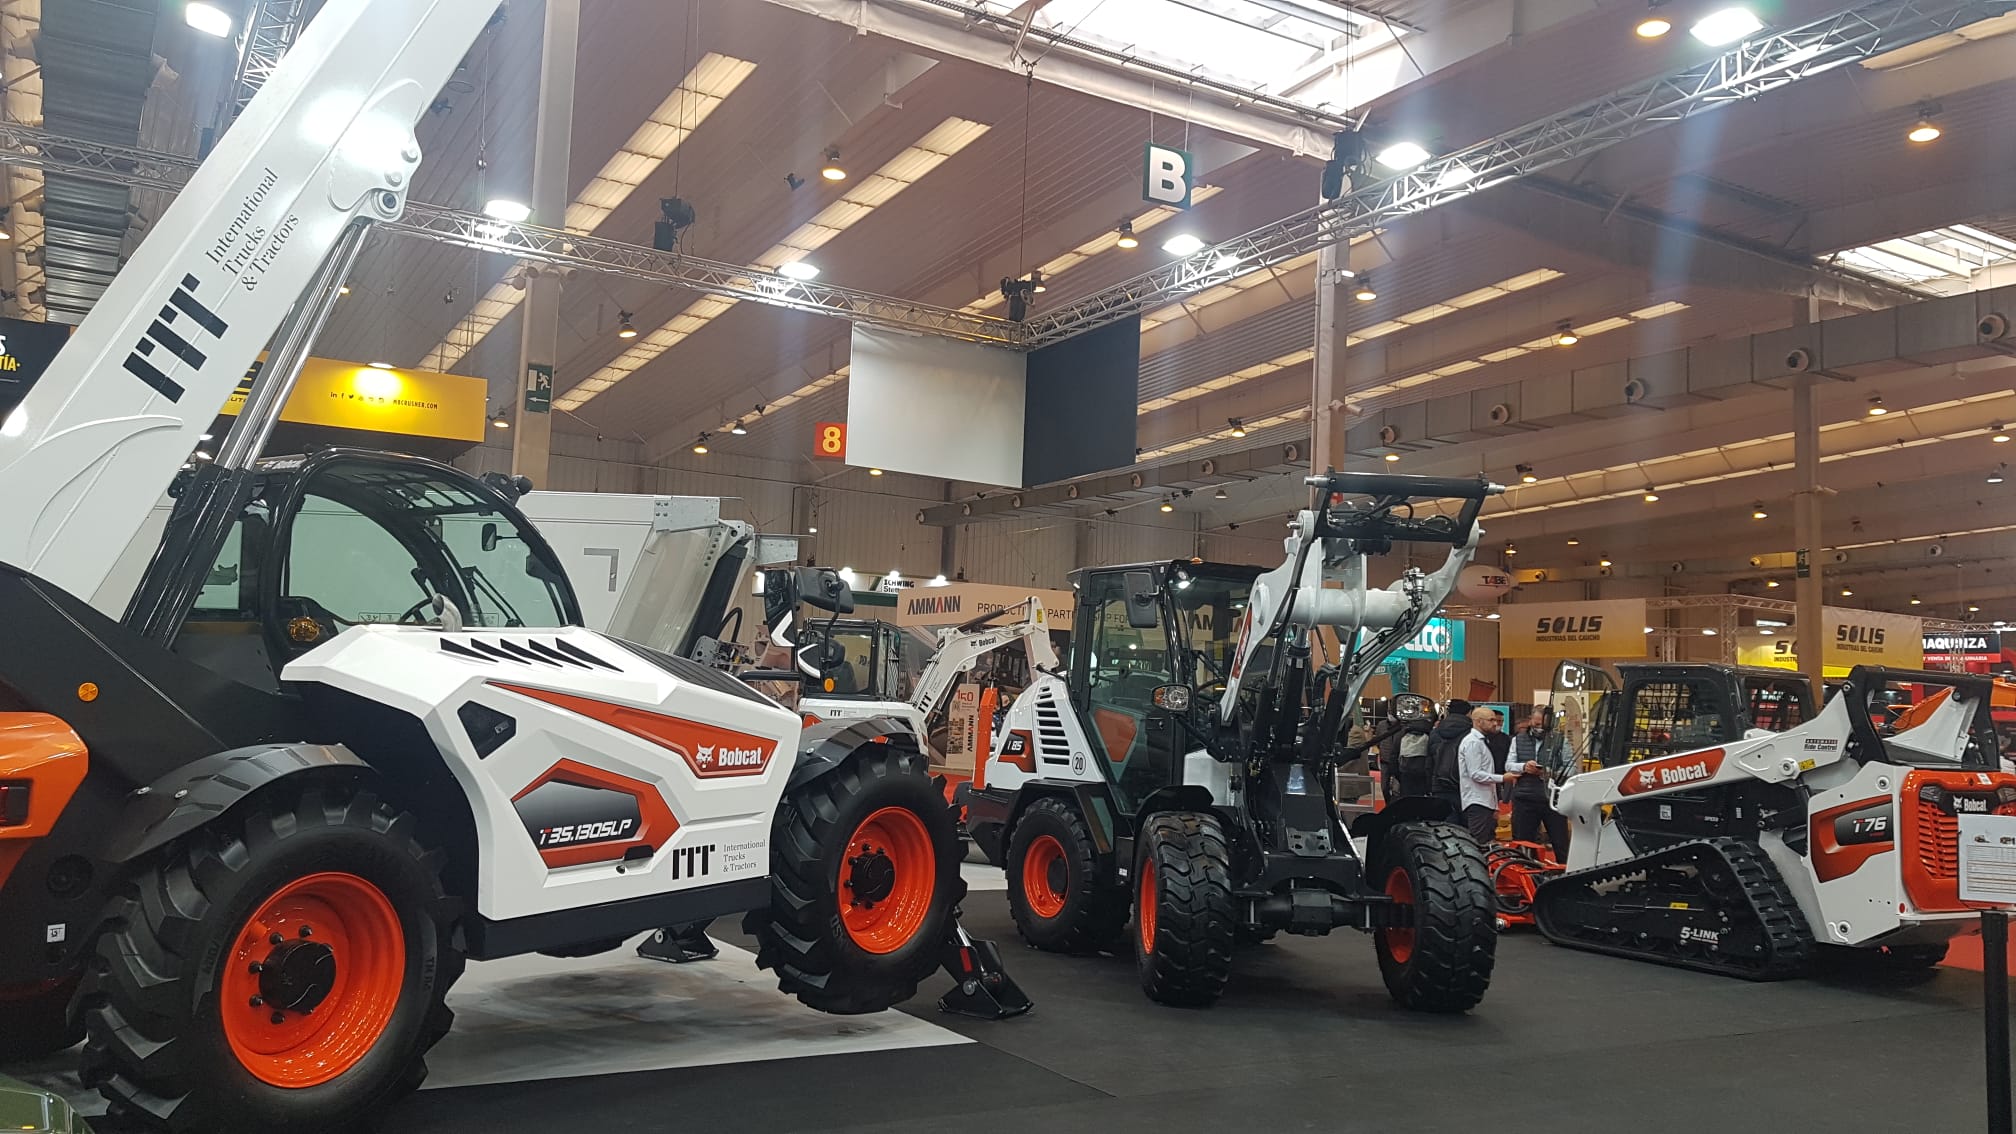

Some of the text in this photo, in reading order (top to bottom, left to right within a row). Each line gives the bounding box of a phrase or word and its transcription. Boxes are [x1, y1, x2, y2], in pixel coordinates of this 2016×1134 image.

[1149, 146, 1186, 202] B
[205, 167, 278, 264] International
[222, 226, 266, 275] Trucks
[241, 214, 299, 291] & Tractors
[822, 426, 841, 453] 8
[907, 595, 961, 616] AMMANN
[1536, 615, 1603, 634] SOLIS
[1836, 624, 1885, 645] SOLIS
[718, 746, 762, 767] Bobcat
[1075, 756, 1084, 771] 20
[1661, 761, 1708, 785] Bobcat
[1963, 798, 1987, 812] Bobcat
[1853, 817, 1887, 833] T76
[723, 839, 766, 852] International
[723, 852, 746, 862] Trucks
[730, 861, 757, 871] Tractors
